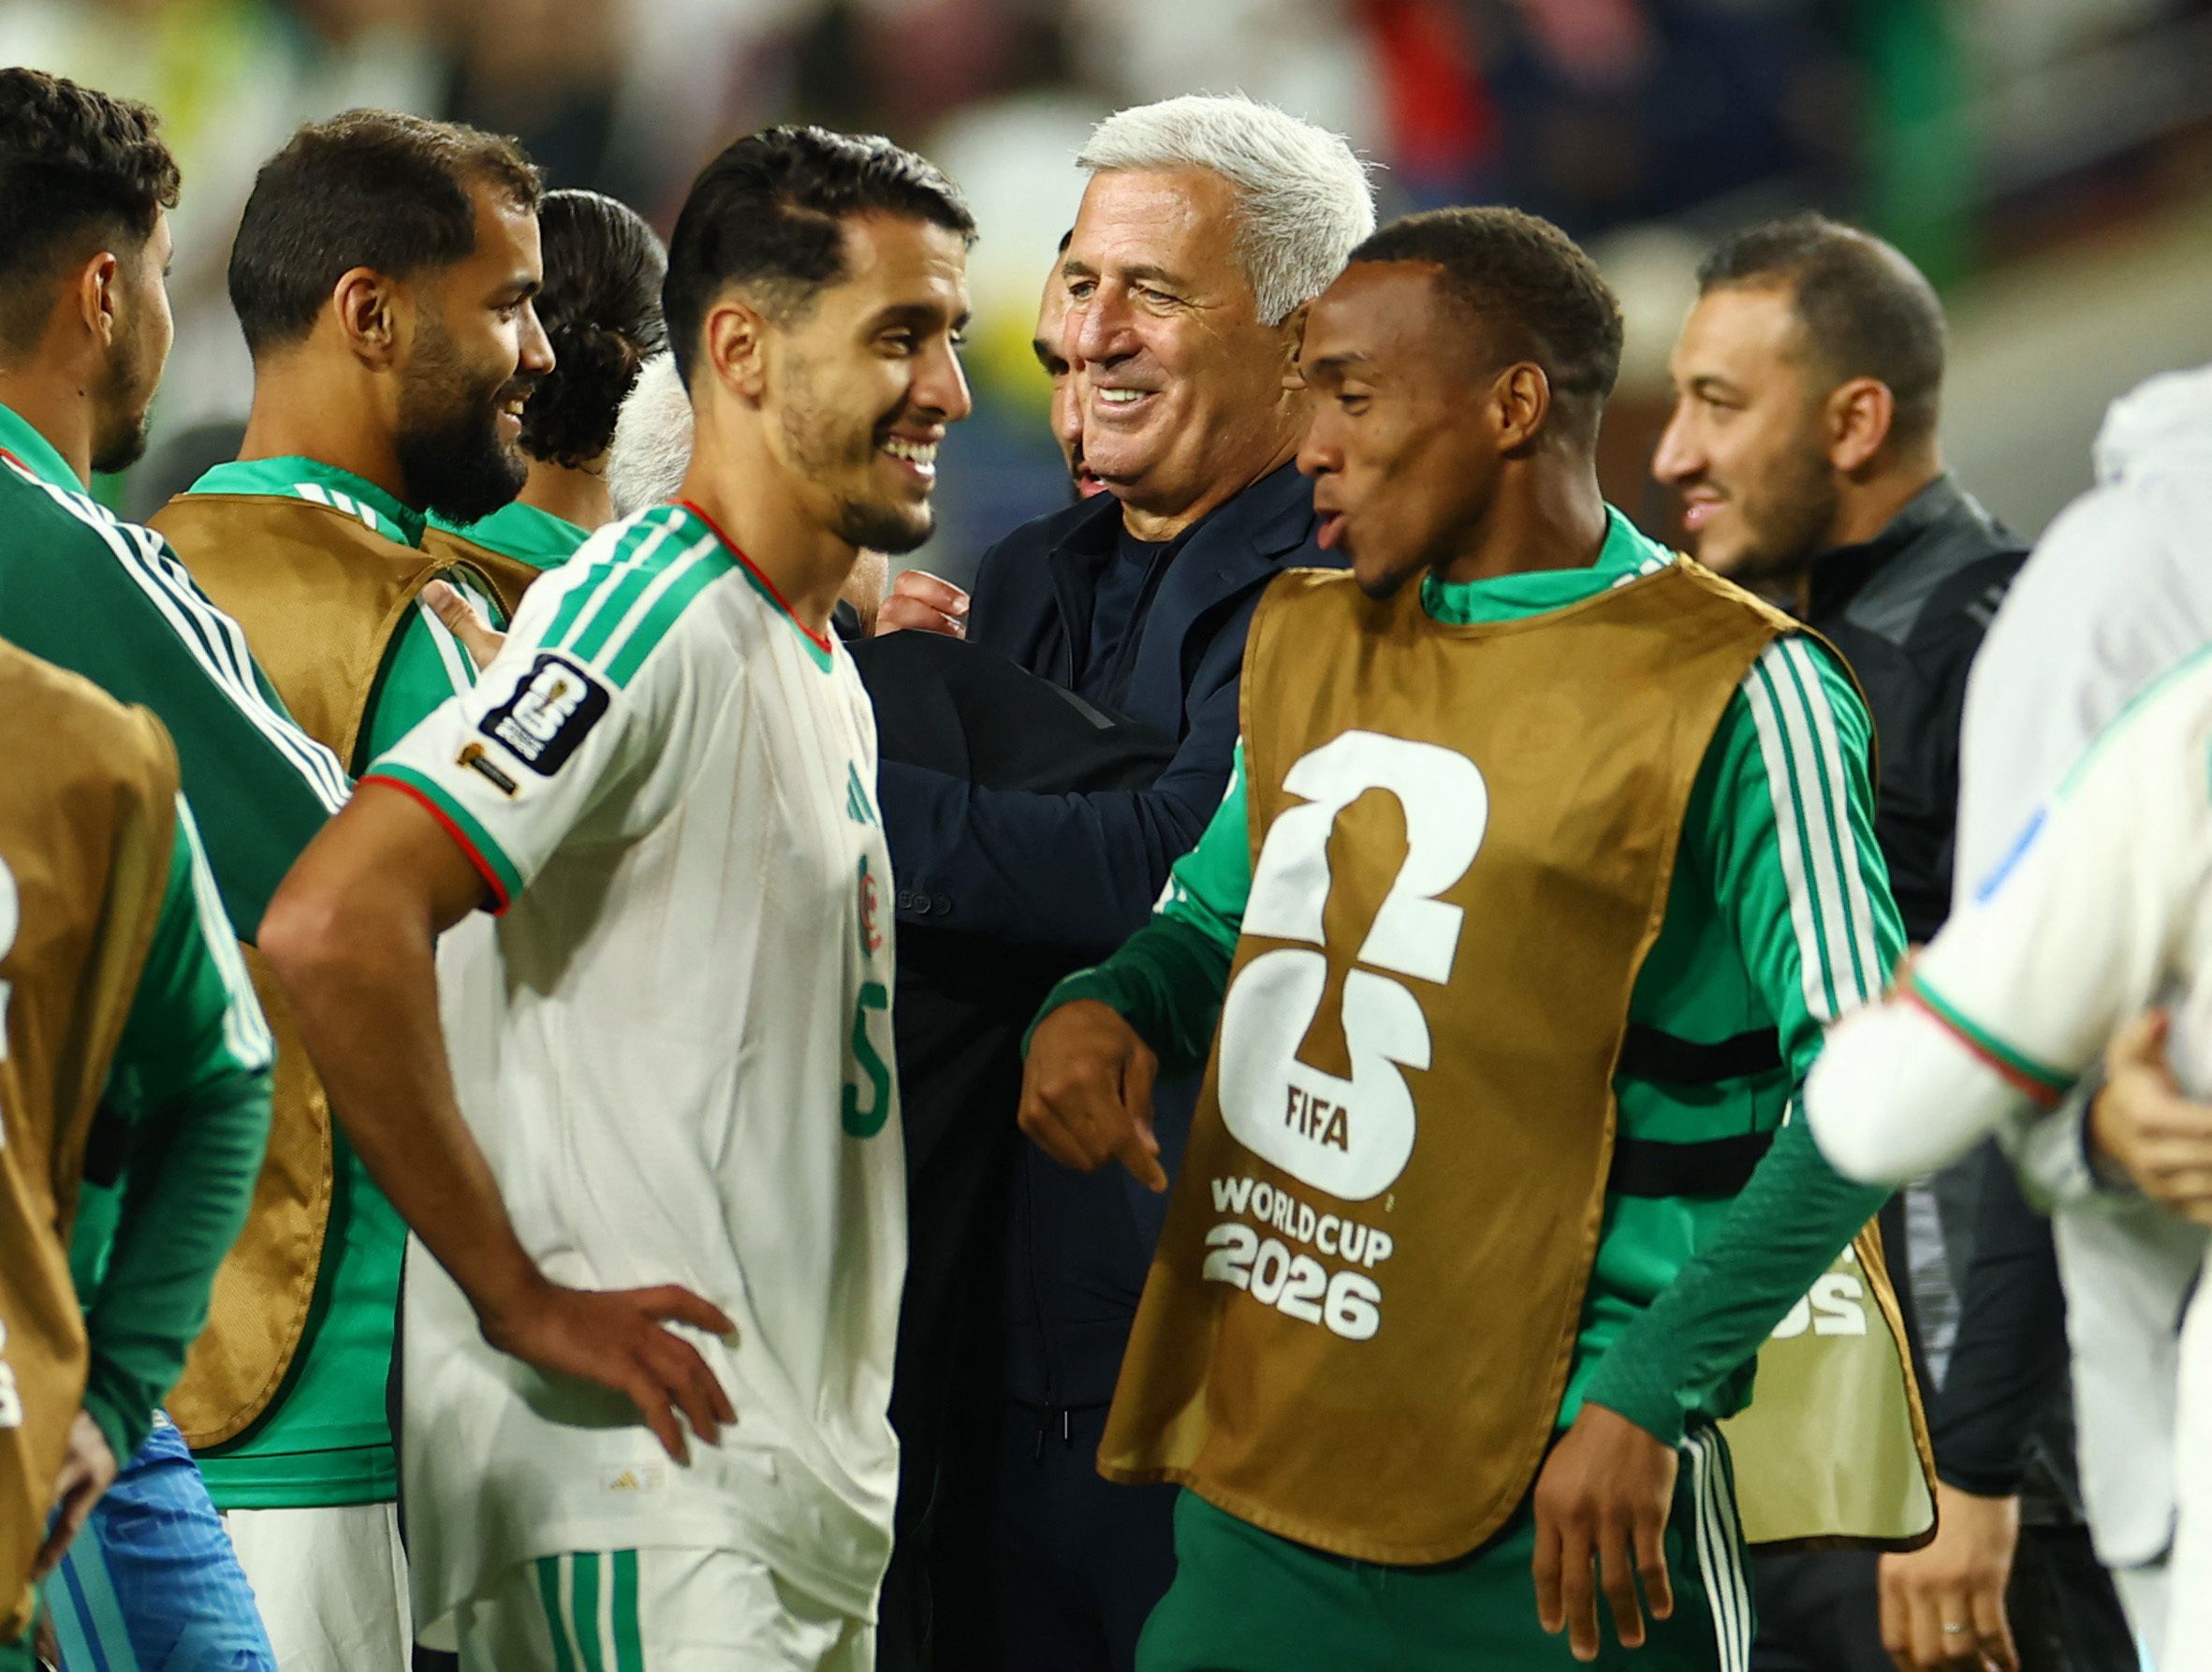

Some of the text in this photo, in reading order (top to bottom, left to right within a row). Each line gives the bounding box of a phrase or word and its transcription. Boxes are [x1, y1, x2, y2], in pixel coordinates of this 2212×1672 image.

[1285, 1085, 1349, 1153] FIFA
[1211, 1176, 1394, 1269] WORLD CUP
[1202, 1222, 1383, 1341] 2026
